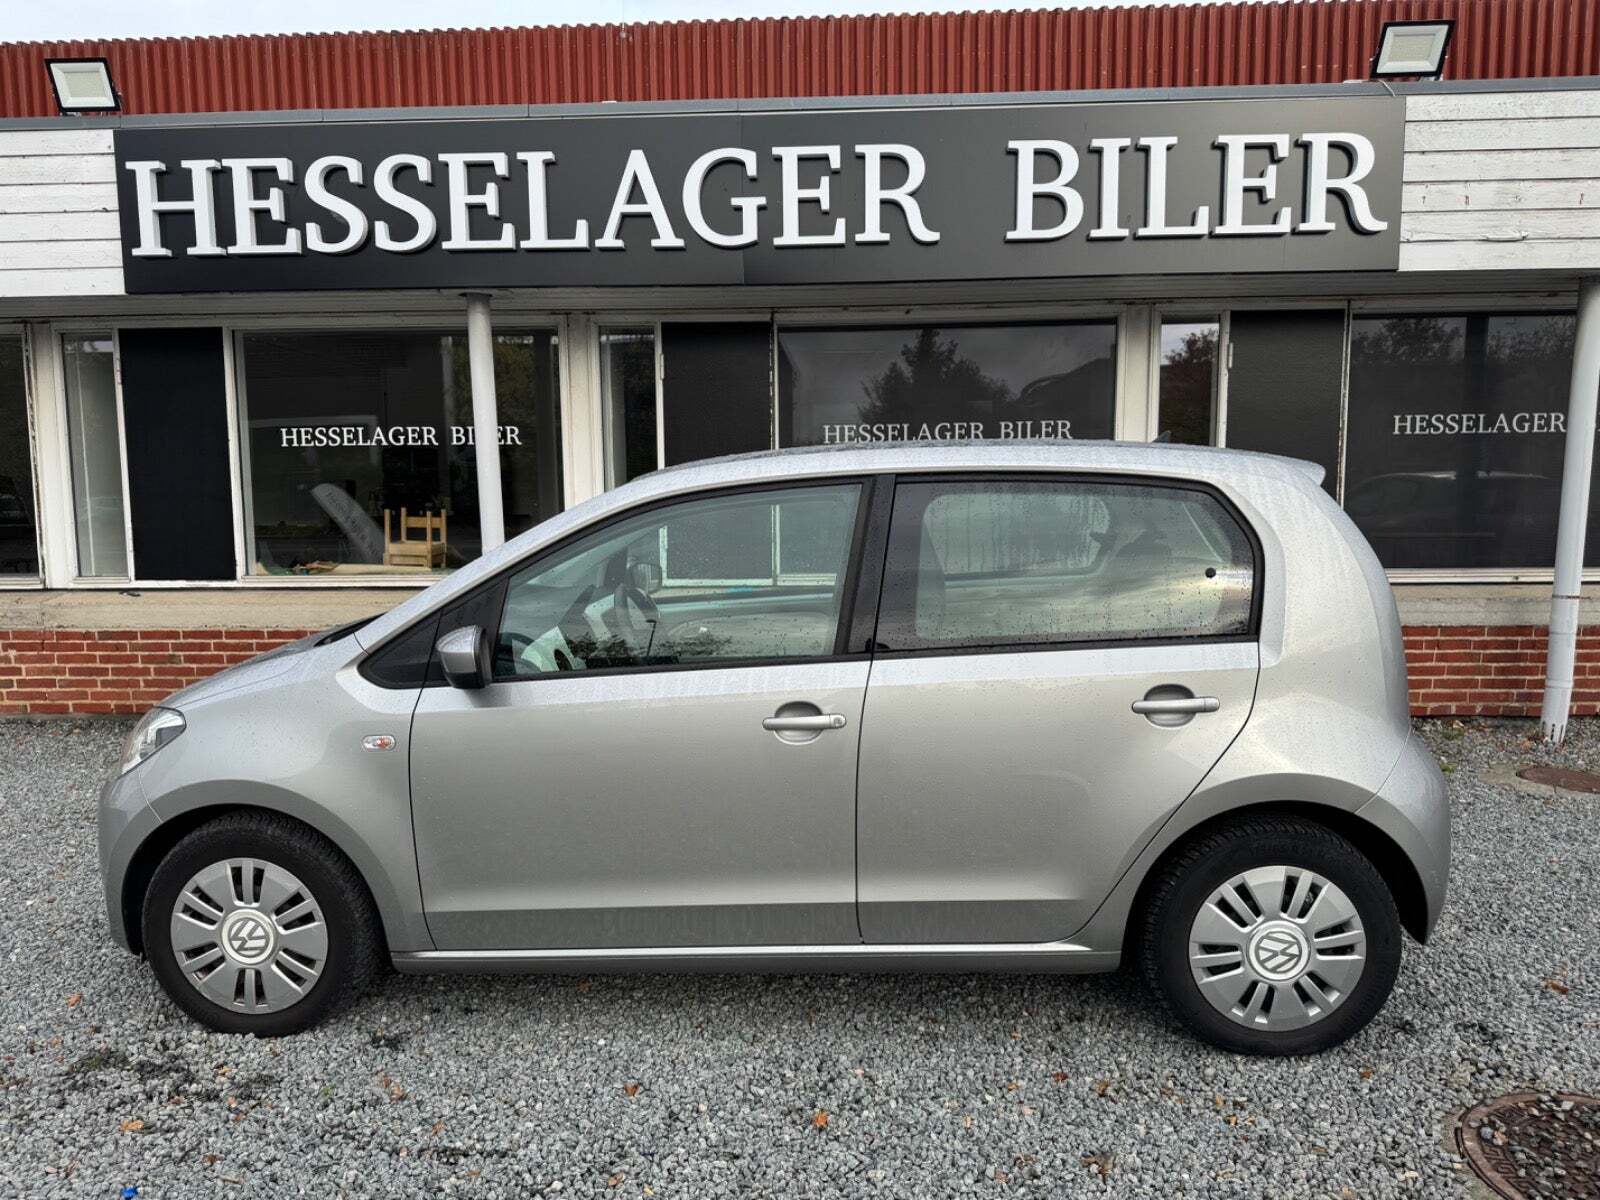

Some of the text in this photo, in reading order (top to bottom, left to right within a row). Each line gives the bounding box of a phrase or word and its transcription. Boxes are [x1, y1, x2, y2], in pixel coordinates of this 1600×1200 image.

[124, 131, 1388, 257] HESSELAGER BILER
[823, 419, 1074, 444] HESSELAGER BILER
[1391, 411, 1567, 435] HESSELAGER
[280, 425, 522, 447] HESSELAGER BIER
